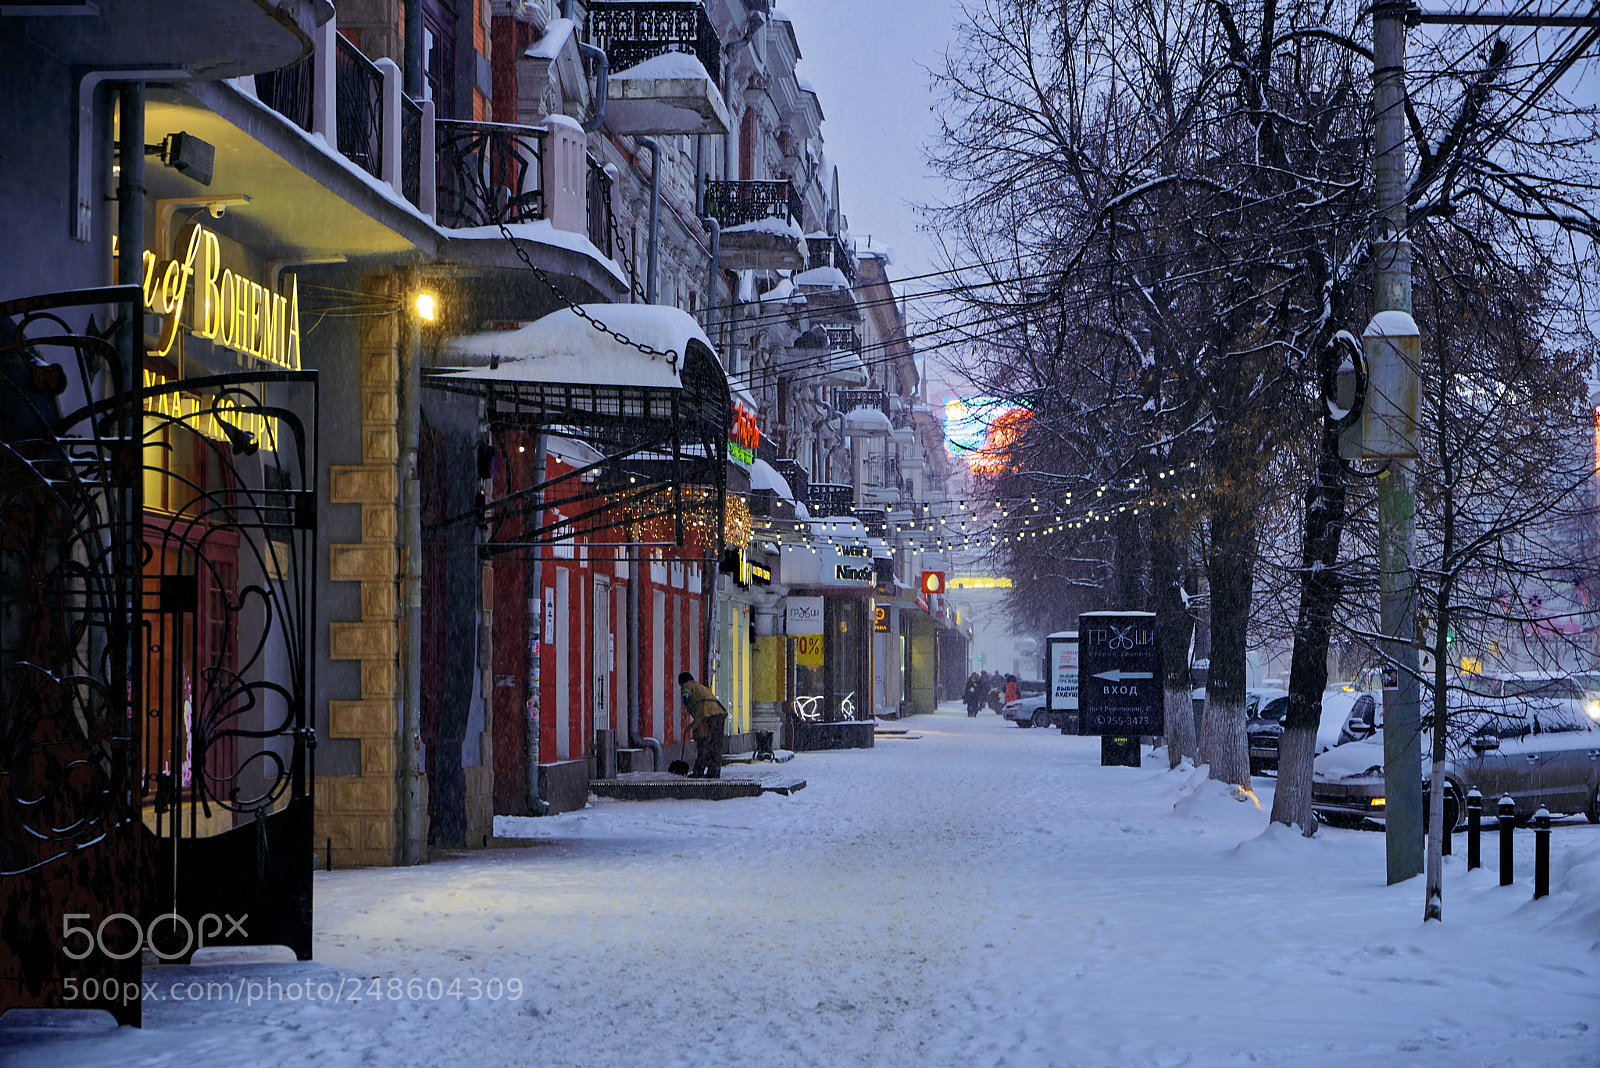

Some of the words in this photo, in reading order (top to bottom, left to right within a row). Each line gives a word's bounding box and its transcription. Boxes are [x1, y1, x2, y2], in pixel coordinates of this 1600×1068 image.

[158, 222, 202, 357] of
[201, 229, 302, 371] BOHEMIA
[1103, 685, 1138, 696] ВХОД
